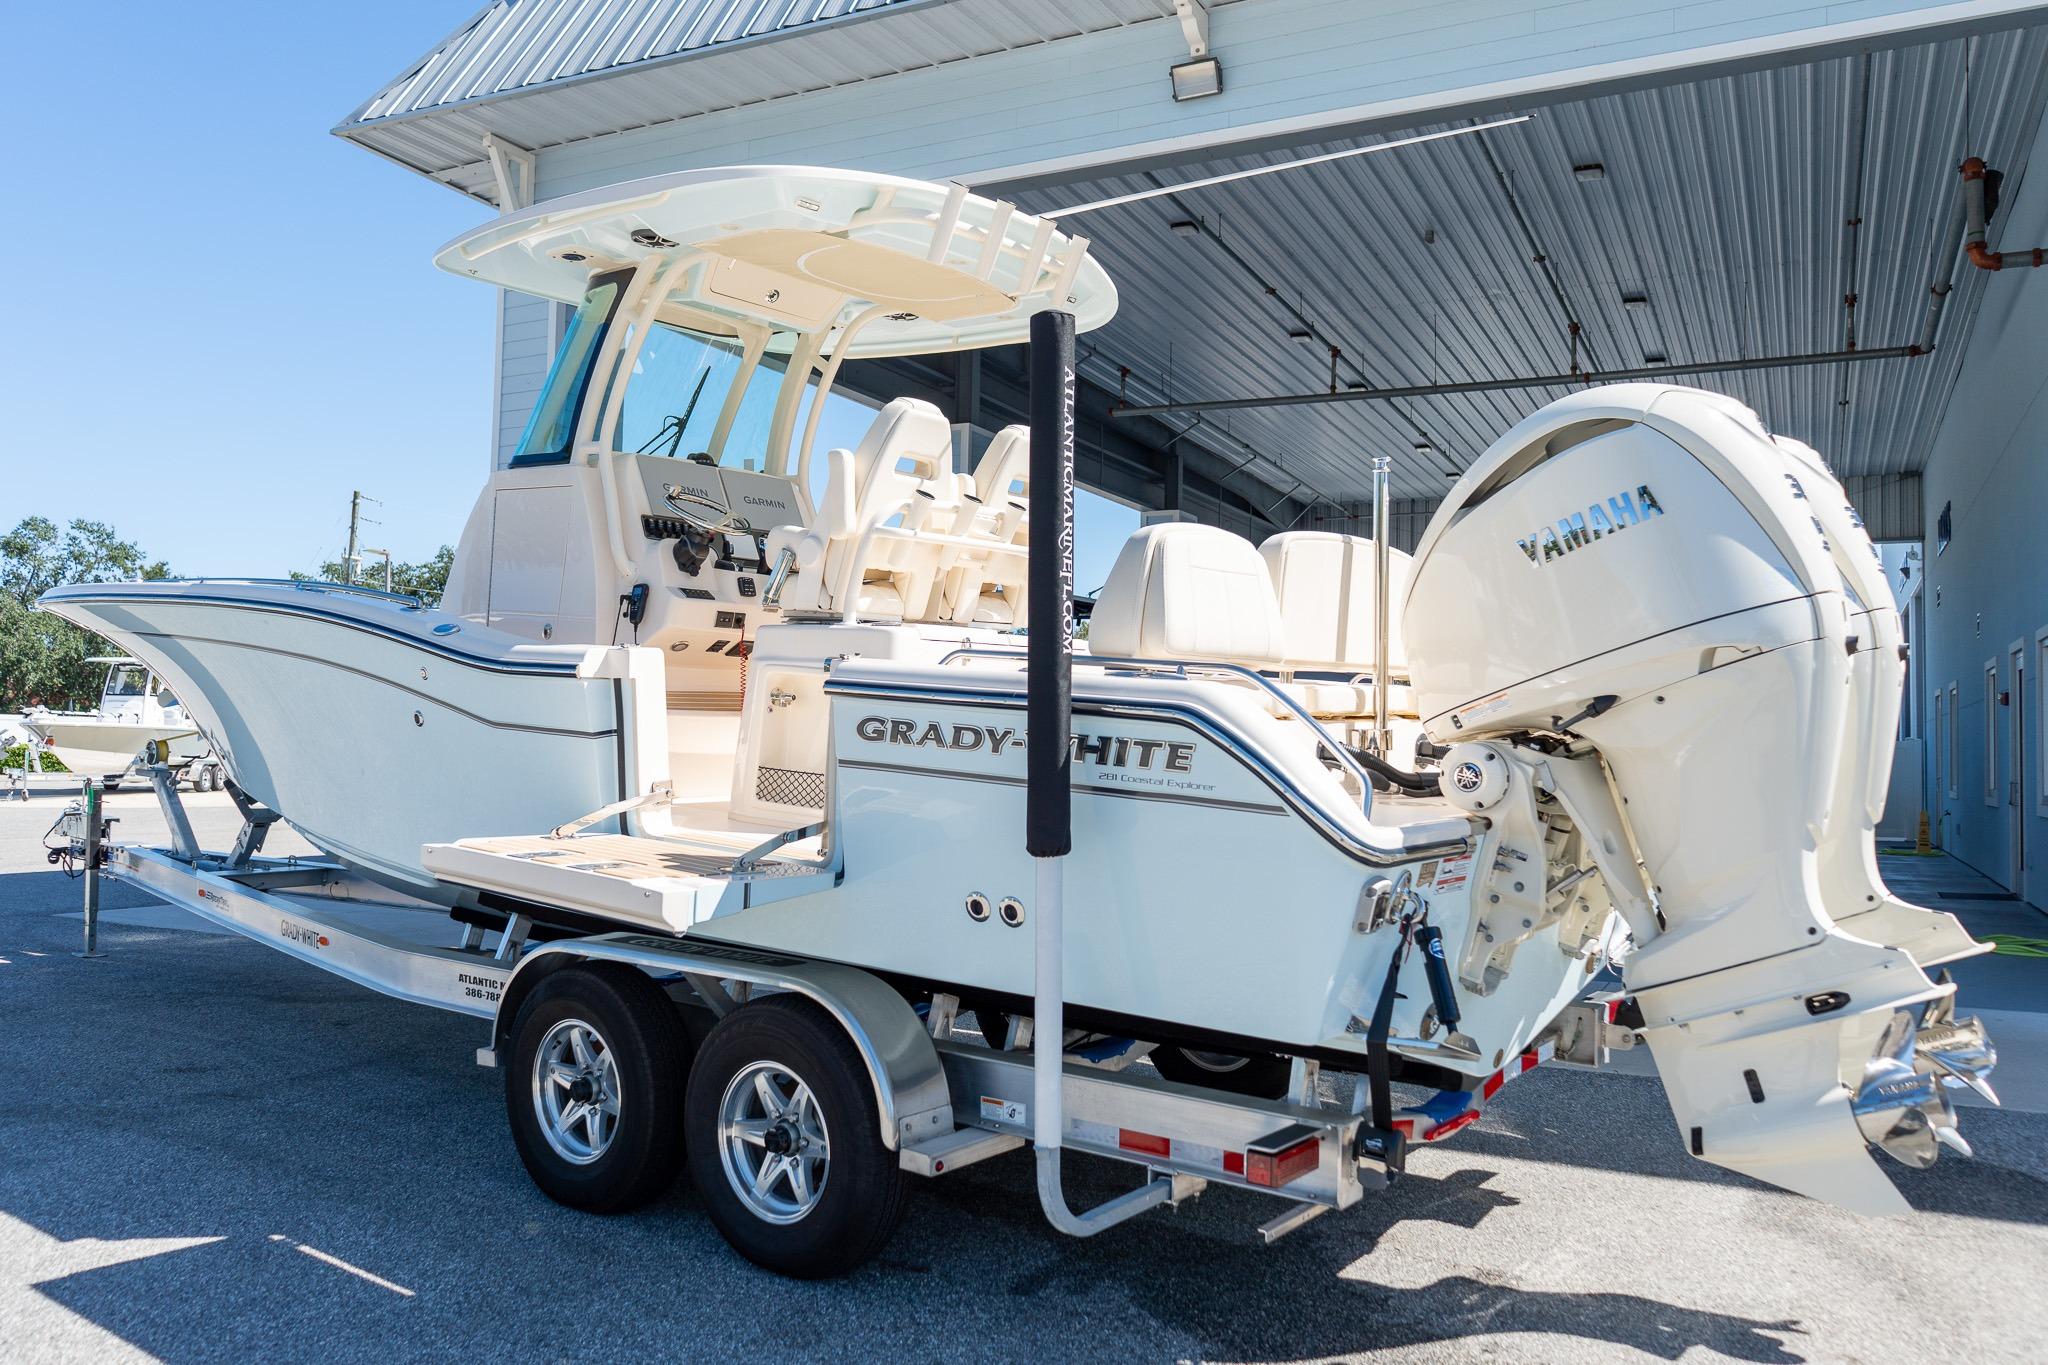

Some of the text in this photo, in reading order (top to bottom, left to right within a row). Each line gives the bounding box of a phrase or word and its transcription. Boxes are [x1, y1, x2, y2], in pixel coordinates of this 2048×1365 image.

[662, 483, 709, 498] GRMIN
[743, 496, 785, 510] GARMIN
[1515, 484, 1664, 569] YAMAHA
[856, 715, 1197, 774] GRADY-HITE
[1099, 772, 1217, 792] 281 Coastal Explorer
[281, 919, 320, 950] GRADY-WHITE
[458, 973, 498, 990] ATLANTIC
